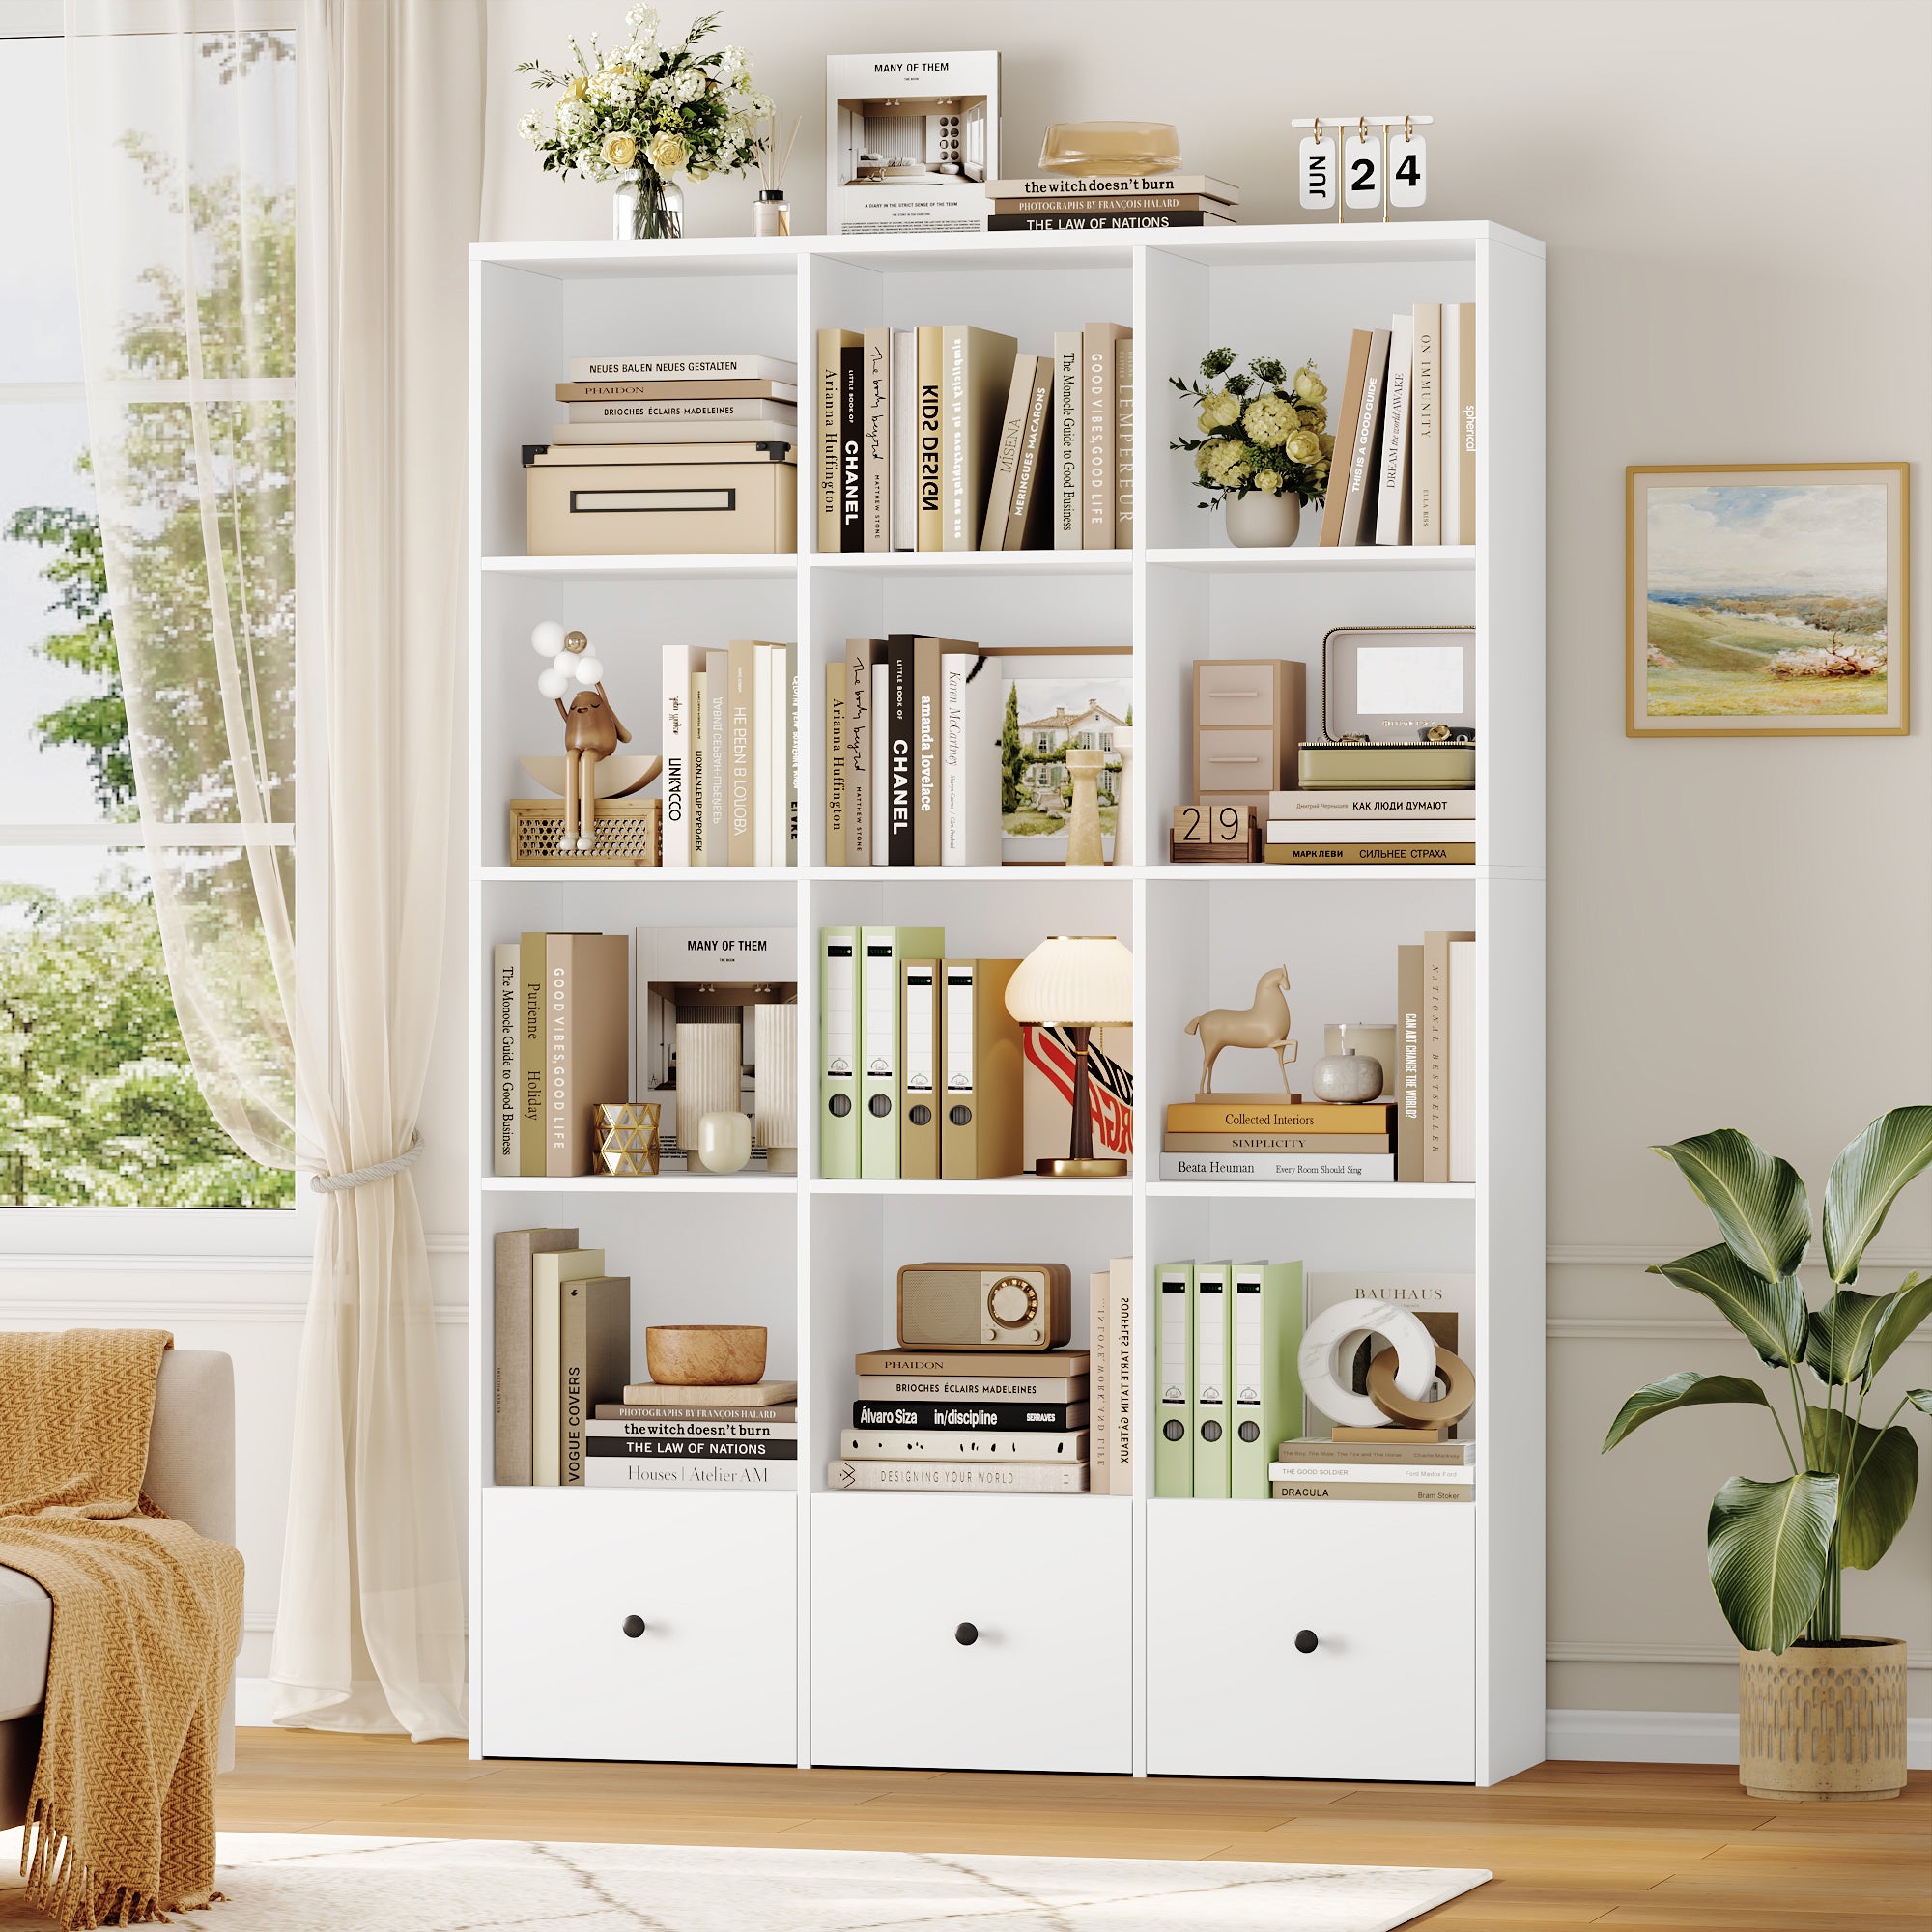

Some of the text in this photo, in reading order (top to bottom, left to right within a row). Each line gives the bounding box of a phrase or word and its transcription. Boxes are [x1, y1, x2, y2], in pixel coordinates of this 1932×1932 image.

[874, 62, 949, 72] MANY OF THEM
[1024, 182, 1047, 193] the
[1048, 180, 1087, 192] witch
[1142, 178, 1175, 189] burn
[1309, 155, 1420, 198] JUN 2 4
[1019, 198, 1179, 211] PHOTOGRAPHS BY FRANÇOIS HALARD
[1026, 216, 1170, 230] THE LAW OF NATIONS
[589, 361, 737, 374] NEUES BAUEN NEUES GESTALTEN
[1092, 354, 1103, 395] GOOD
[585, 386, 645, 395] PHAIDON
[1421, 334, 1431, 439] ON IMMUNITY
[604, 405, 734, 416] BRIOCHES ÉCLAIRS MADELEINES
[821, 369, 838, 513] Arianna Huffington
[1351, 377, 1378, 493] THIS IS A GOOD GUIDE
[1386, 373, 1404, 489] DREAM the world AWAKE
[1014, 387, 1046, 516] MERINGUES MACARONS
[1064, 352, 1075, 531] The Monocle Guide to Good Business
[1092, 446, 1103, 488] GOOD
[844, 440, 859, 526] CHANEL
[1092, 494, 1103, 525] LIFE
[896, 708, 903, 720] OF
[945, 671, 961, 767] Karen McCartney
[921, 696, 934, 812] amanda lovelace
[830, 698, 845, 831] Arianna Huffington
[893, 739, 908, 836] CHANEL
[1352, 801, 1448, 810] КАК ЛЮДИ ДУМАЮТ
[1182, 808, 1238, 840] 2 9
[1293, 850, 1447, 859] МАРК ЛЕВИ СИЛЬНЕЕ СТРАХА
[687, 940, 768, 952] MANY OF THEM
[554, 968, 565, 1012] GOOD
[502, 966, 514, 1155] The Monocle Guide to Good Business
[524, 983, 541, 1121] Purienne Holiday
[1405, 1013, 1417, 1119] CAN ART CHANGE THE WORLD?
[554, 1066, 565, 1111] GOOD
[1225, 1113, 1315, 1125] Collected Interiors
[554, 1117, 565, 1150] LIFE
[1232, 1139, 1307, 1148] SIMPLICITY
[1178, 1161, 1255, 1173] Beata Heuman
[1275, 1165, 1362, 1175] Every Room Should Sing
[1355, 1289, 1442, 1299] BAUHAUS
[885, 1361, 945, 1370] PHAIDON
[895, 1381, 1037, 1394] BRIOCHES ÉCLAIRS MADELEINES
[619, 1407, 777, 1420] PHOTOGRAPHS BY FRANÇOIS HALARD
[860, 1405, 894, 1425] Álvaro
[895, 1408, 918, 1425] Siza
[933, 1409, 998, 1428] in/discipline
[569, 1366, 580, 1482] VOGUE COVERS
[624, 1424, 646, 1435] the
[647, 1424, 685, 1435] witch
[739, 1425, 771, 1436] burn
[626, 1442, 766, 1455] THE LAW OF NATIONS
[628, 1465, 767, 1483] Houses Atelier AM
[881, 1470, 1014, 1484] DESIGNING YOUR WORLD
[1281, 1488, 1329, 1497] DRACULA
